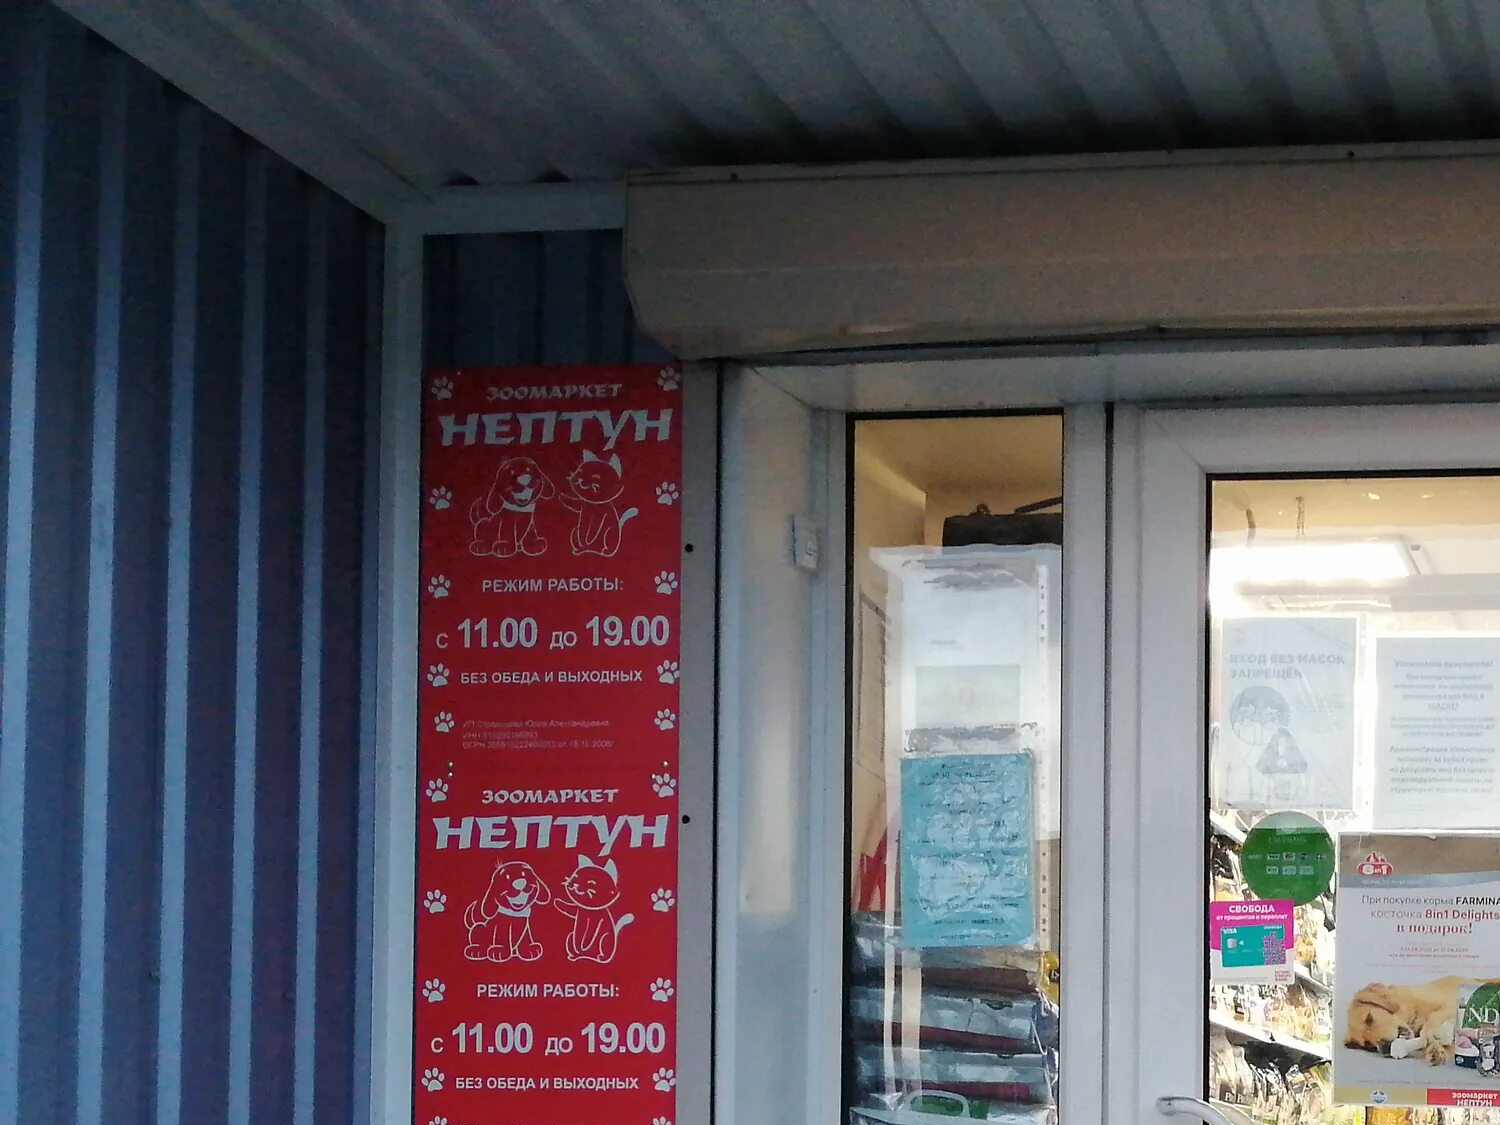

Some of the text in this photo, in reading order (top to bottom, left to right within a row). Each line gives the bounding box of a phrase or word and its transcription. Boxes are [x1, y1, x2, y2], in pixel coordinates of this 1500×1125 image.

[486, 383, 623, 401] ЗООМАРКЕТ
[437, 408, 673, 451] НЕПТУН
[482, 577, 624, 593] РЕЖИМ РАБОТЫ:
[457, 617, 538, 649] 11.00
[586, 615, 670, 647] 19.00
[461, 670, 642, 685] БЕЗ ОБЕДА И ВЫХОДНЫХ
[482, 788, 619, 805] ЗООМАРКЕТ
[432, 814, 668, 857] НЕПТУН
[1362, 894, 1381, 906] При
[1383, 895, 1422, 906] покупке
[1424, 896, 1454, 906] корма
[1228, 904, 1276, 914] СВОБОДА
[1425, 909, 1449, 919] 8in1
[1452, 908, 1500, 922] Delights
[1397, 922, 1473, 936] в подарок!
[477, 983, 620, 998] РЕЖИМ РАБОТЫ:
[452, 1022, 533, 1053] 11.00
[581, 1022, 666, 1053] 19.00
[455, 1076, 639, 1092] БЕЗ ОБЕДА И ВЫХОДНЫХ
[1457, 1099, 1493, 1107] НЕПТУН
